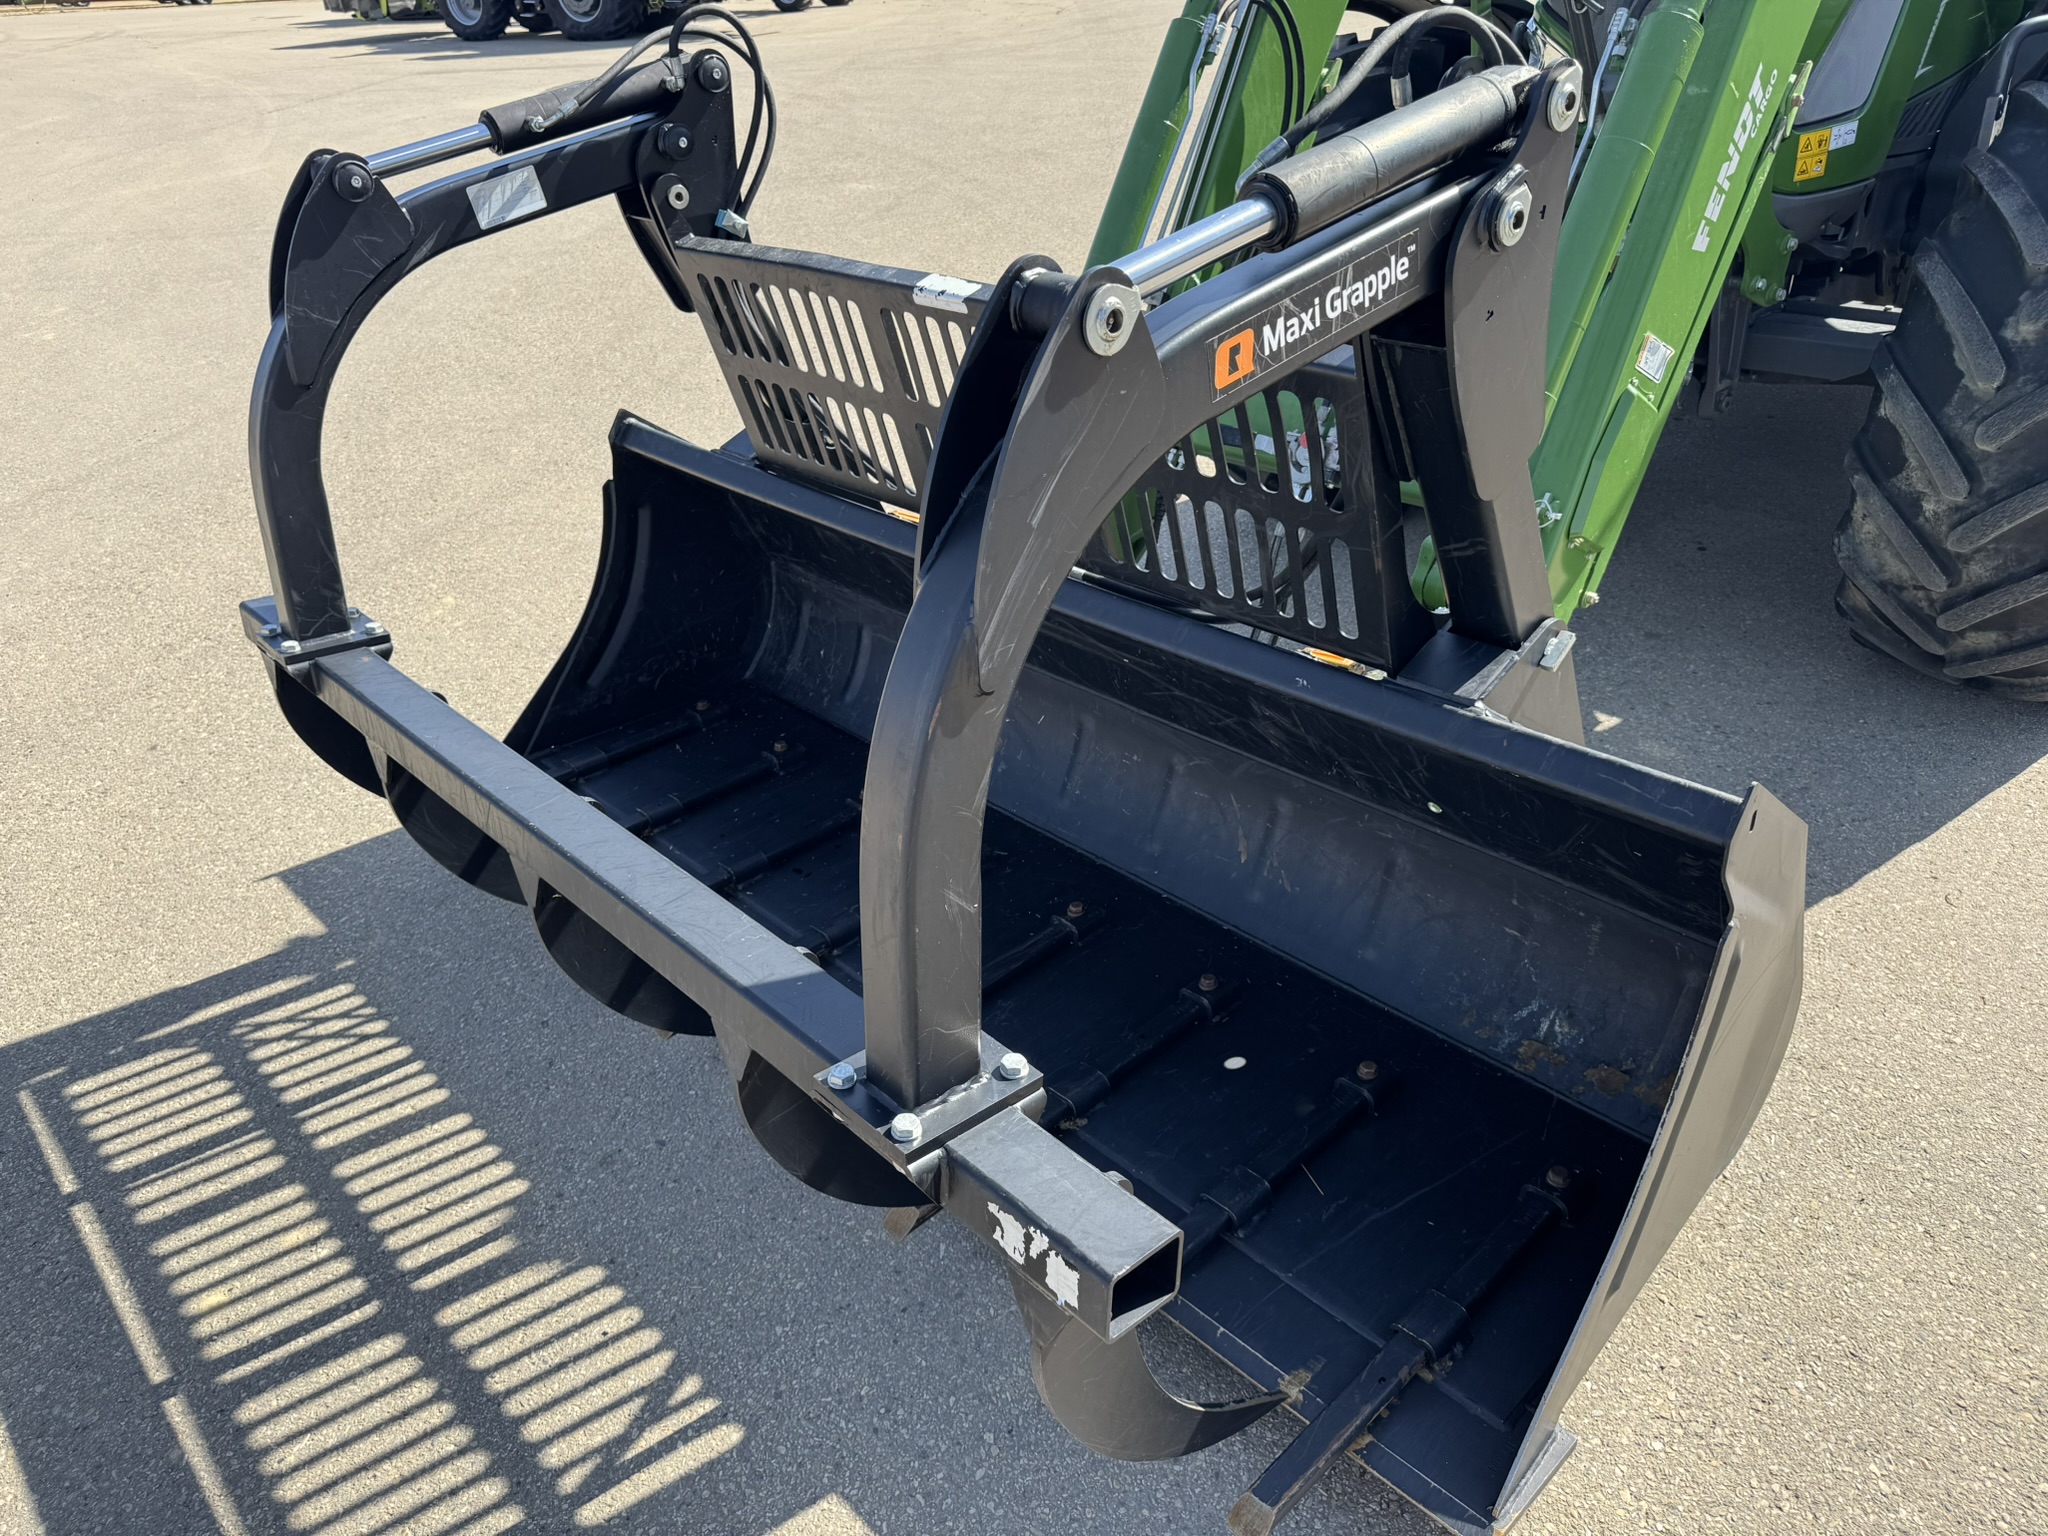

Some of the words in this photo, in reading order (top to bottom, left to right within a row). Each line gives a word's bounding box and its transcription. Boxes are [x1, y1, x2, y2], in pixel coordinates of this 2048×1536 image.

[1751, 68, 1778, 139] CARGO
[1691, 61, 1764, 253] FENDT
[1262, 298, 1320, 356] Maxi
